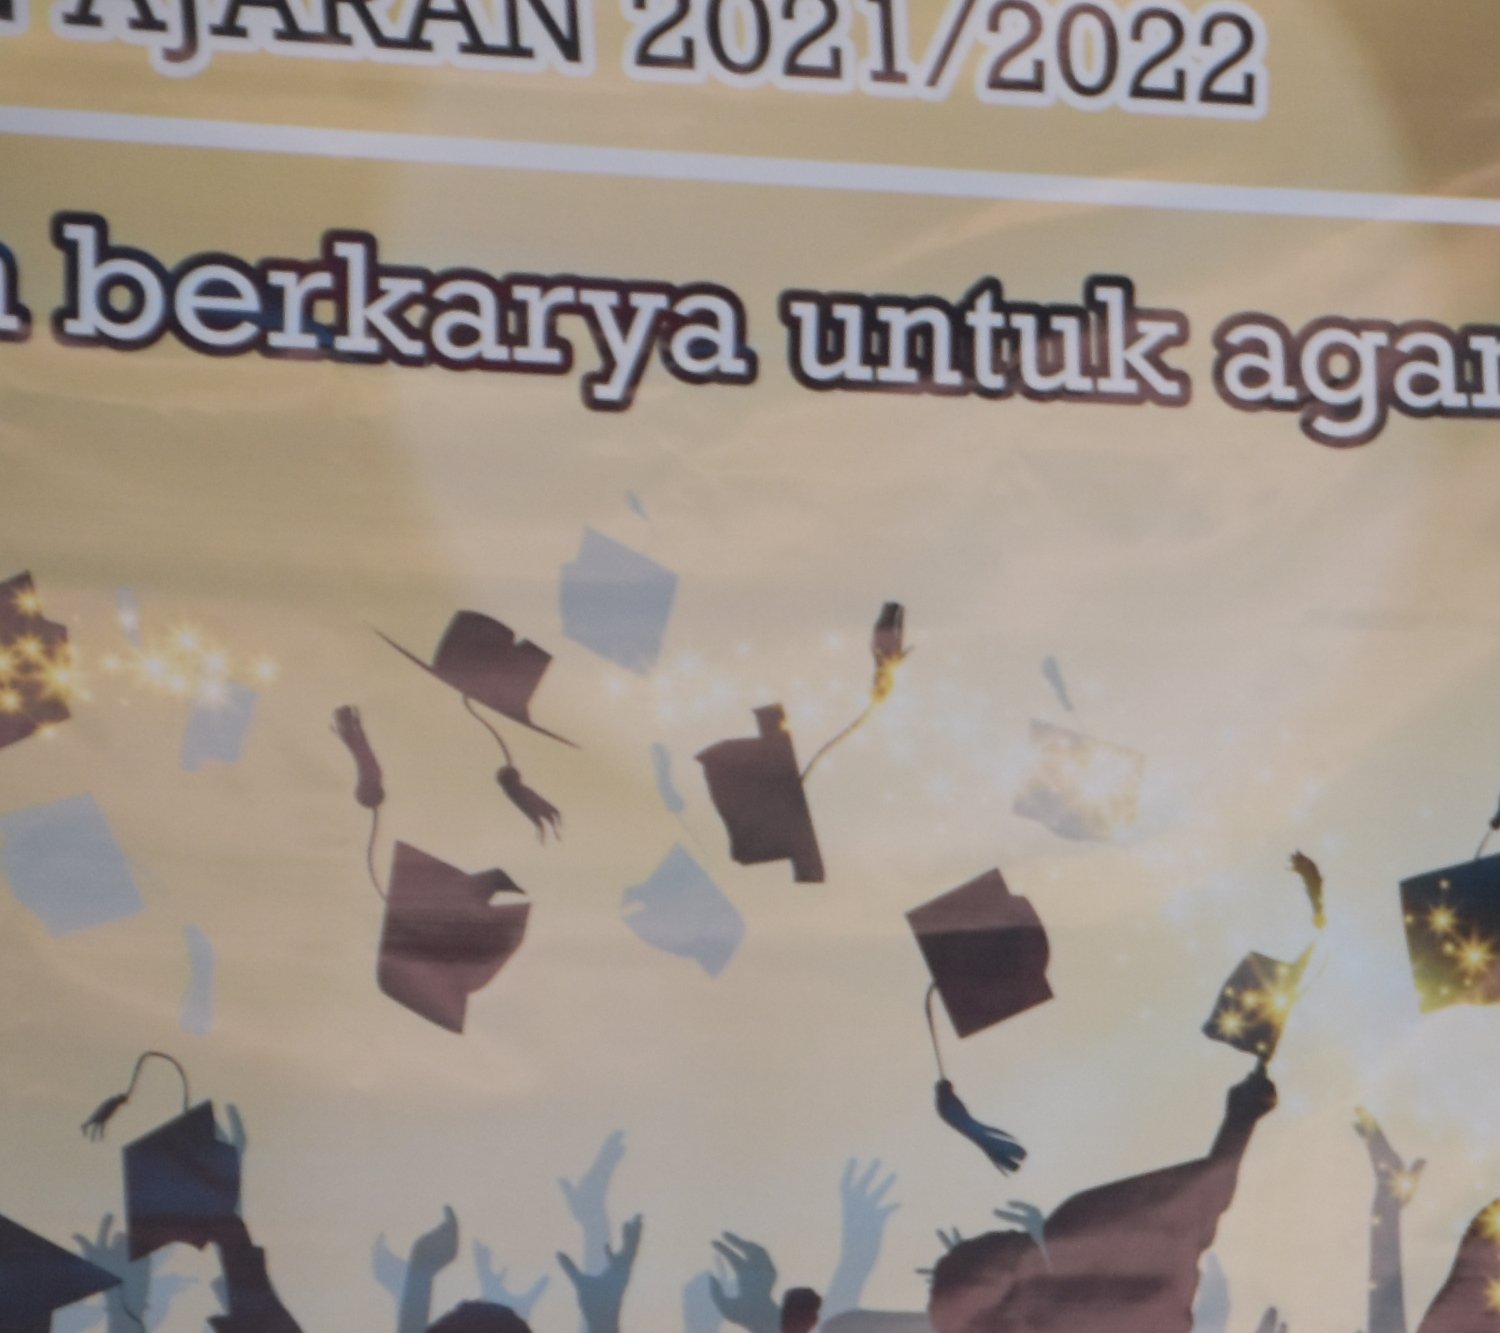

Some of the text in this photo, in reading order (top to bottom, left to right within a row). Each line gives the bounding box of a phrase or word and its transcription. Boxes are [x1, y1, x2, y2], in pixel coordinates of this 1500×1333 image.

[632, 0, 1257, 106] 2021/2022
[58, 219, 752, 404] berkarya
[786, 283, 1185, 398] untuk
